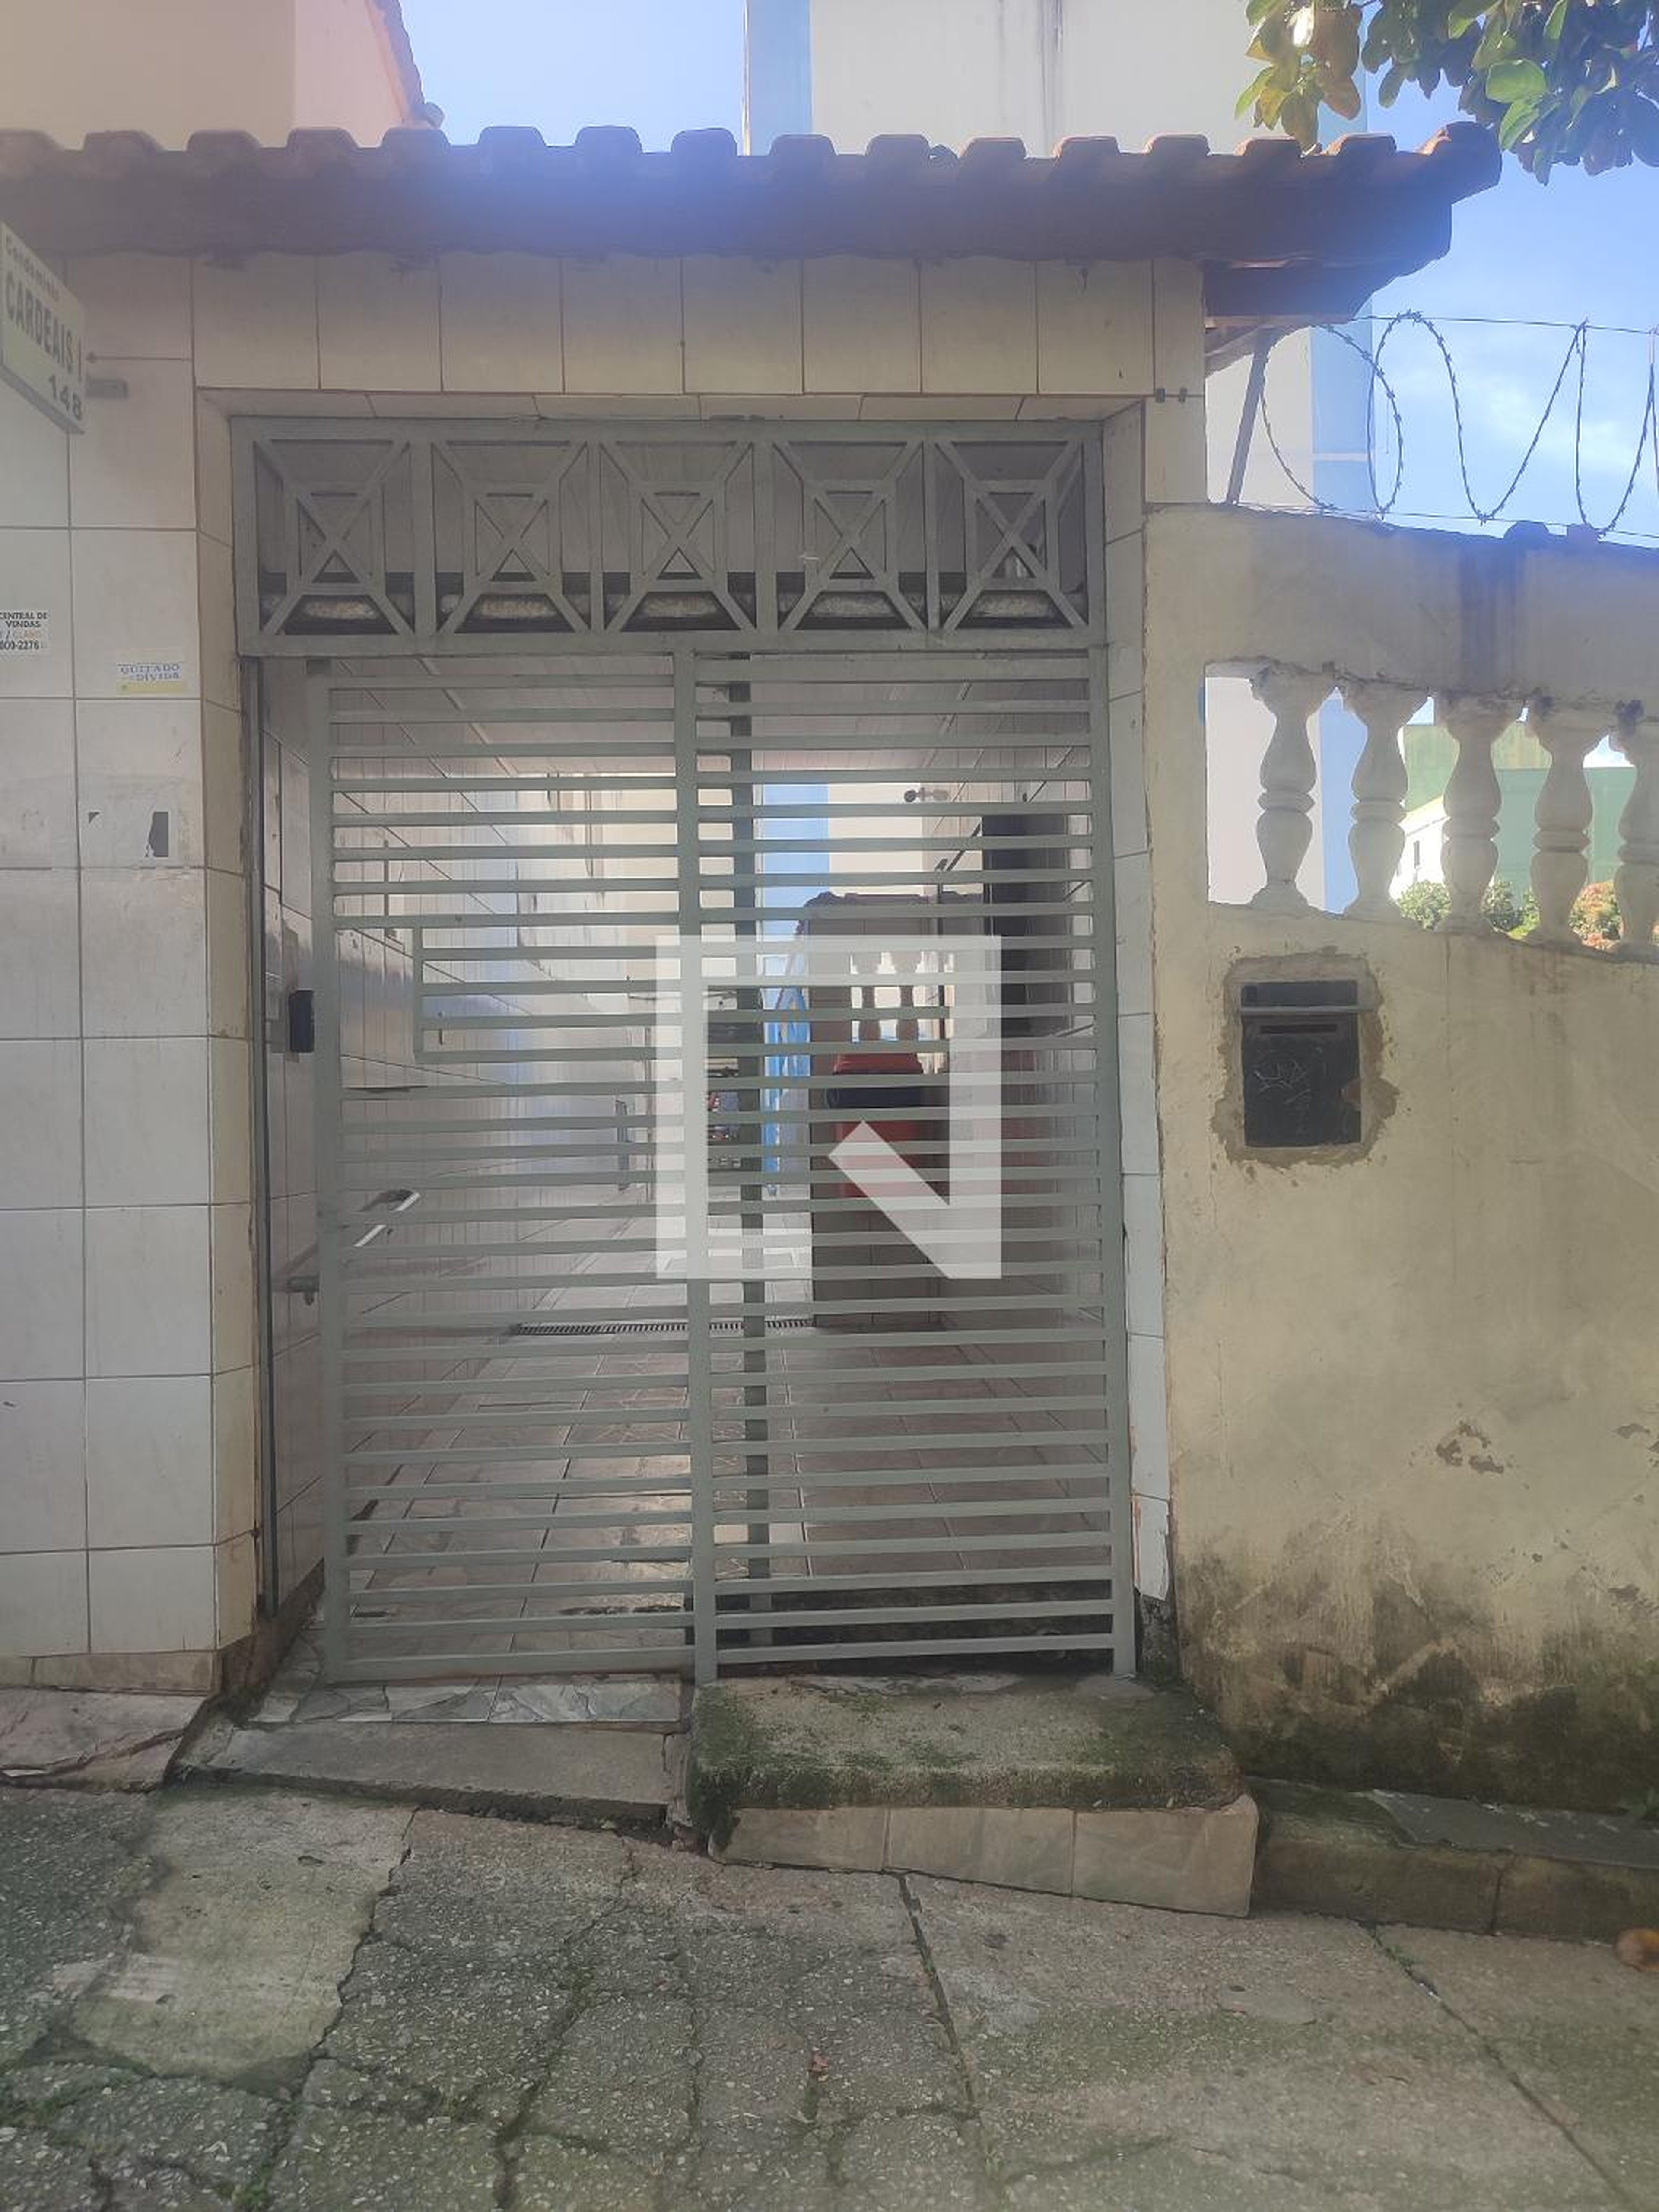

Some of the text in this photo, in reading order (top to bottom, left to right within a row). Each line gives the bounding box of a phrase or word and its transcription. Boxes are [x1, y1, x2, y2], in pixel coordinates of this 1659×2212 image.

[6, 270, 73, 374] CARDEAIS
[48, 374, 82, 420] 148
[5, 620, 41, 628] VENDAS
